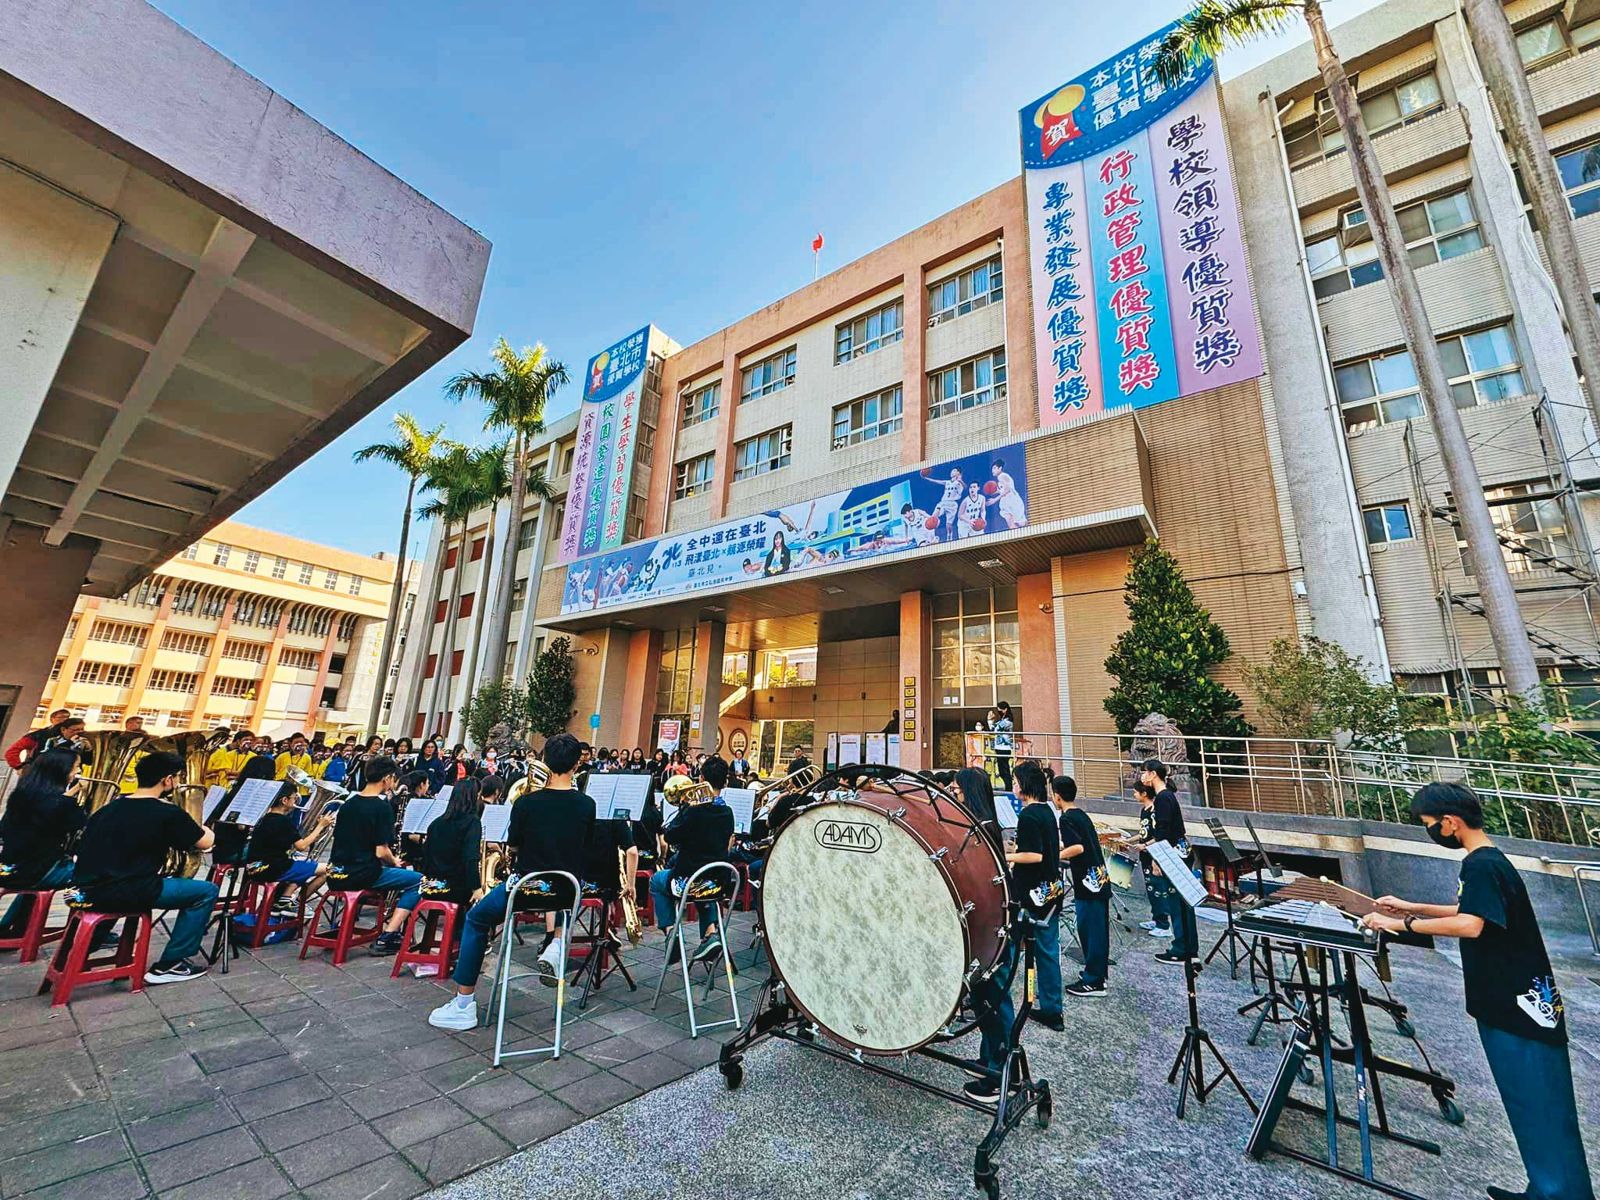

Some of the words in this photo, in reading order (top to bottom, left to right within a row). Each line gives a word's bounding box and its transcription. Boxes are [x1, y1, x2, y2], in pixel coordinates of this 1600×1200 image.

[1044, 118, 1072, 147] 賀
[1167, 114, 1242, 374] 學校領導優質獎
[1100, 150, 1162, 394] 行政管理優質獎
[1043, 182, 1091, 416] 專業發展優質獎
[607, 359, 640, 386] 優質學校
[609, 344, 643, 373] 臺北市
[686, 520, 766, 551] 全中運在臺北
[822, 823, 876, 850] ADAMS
